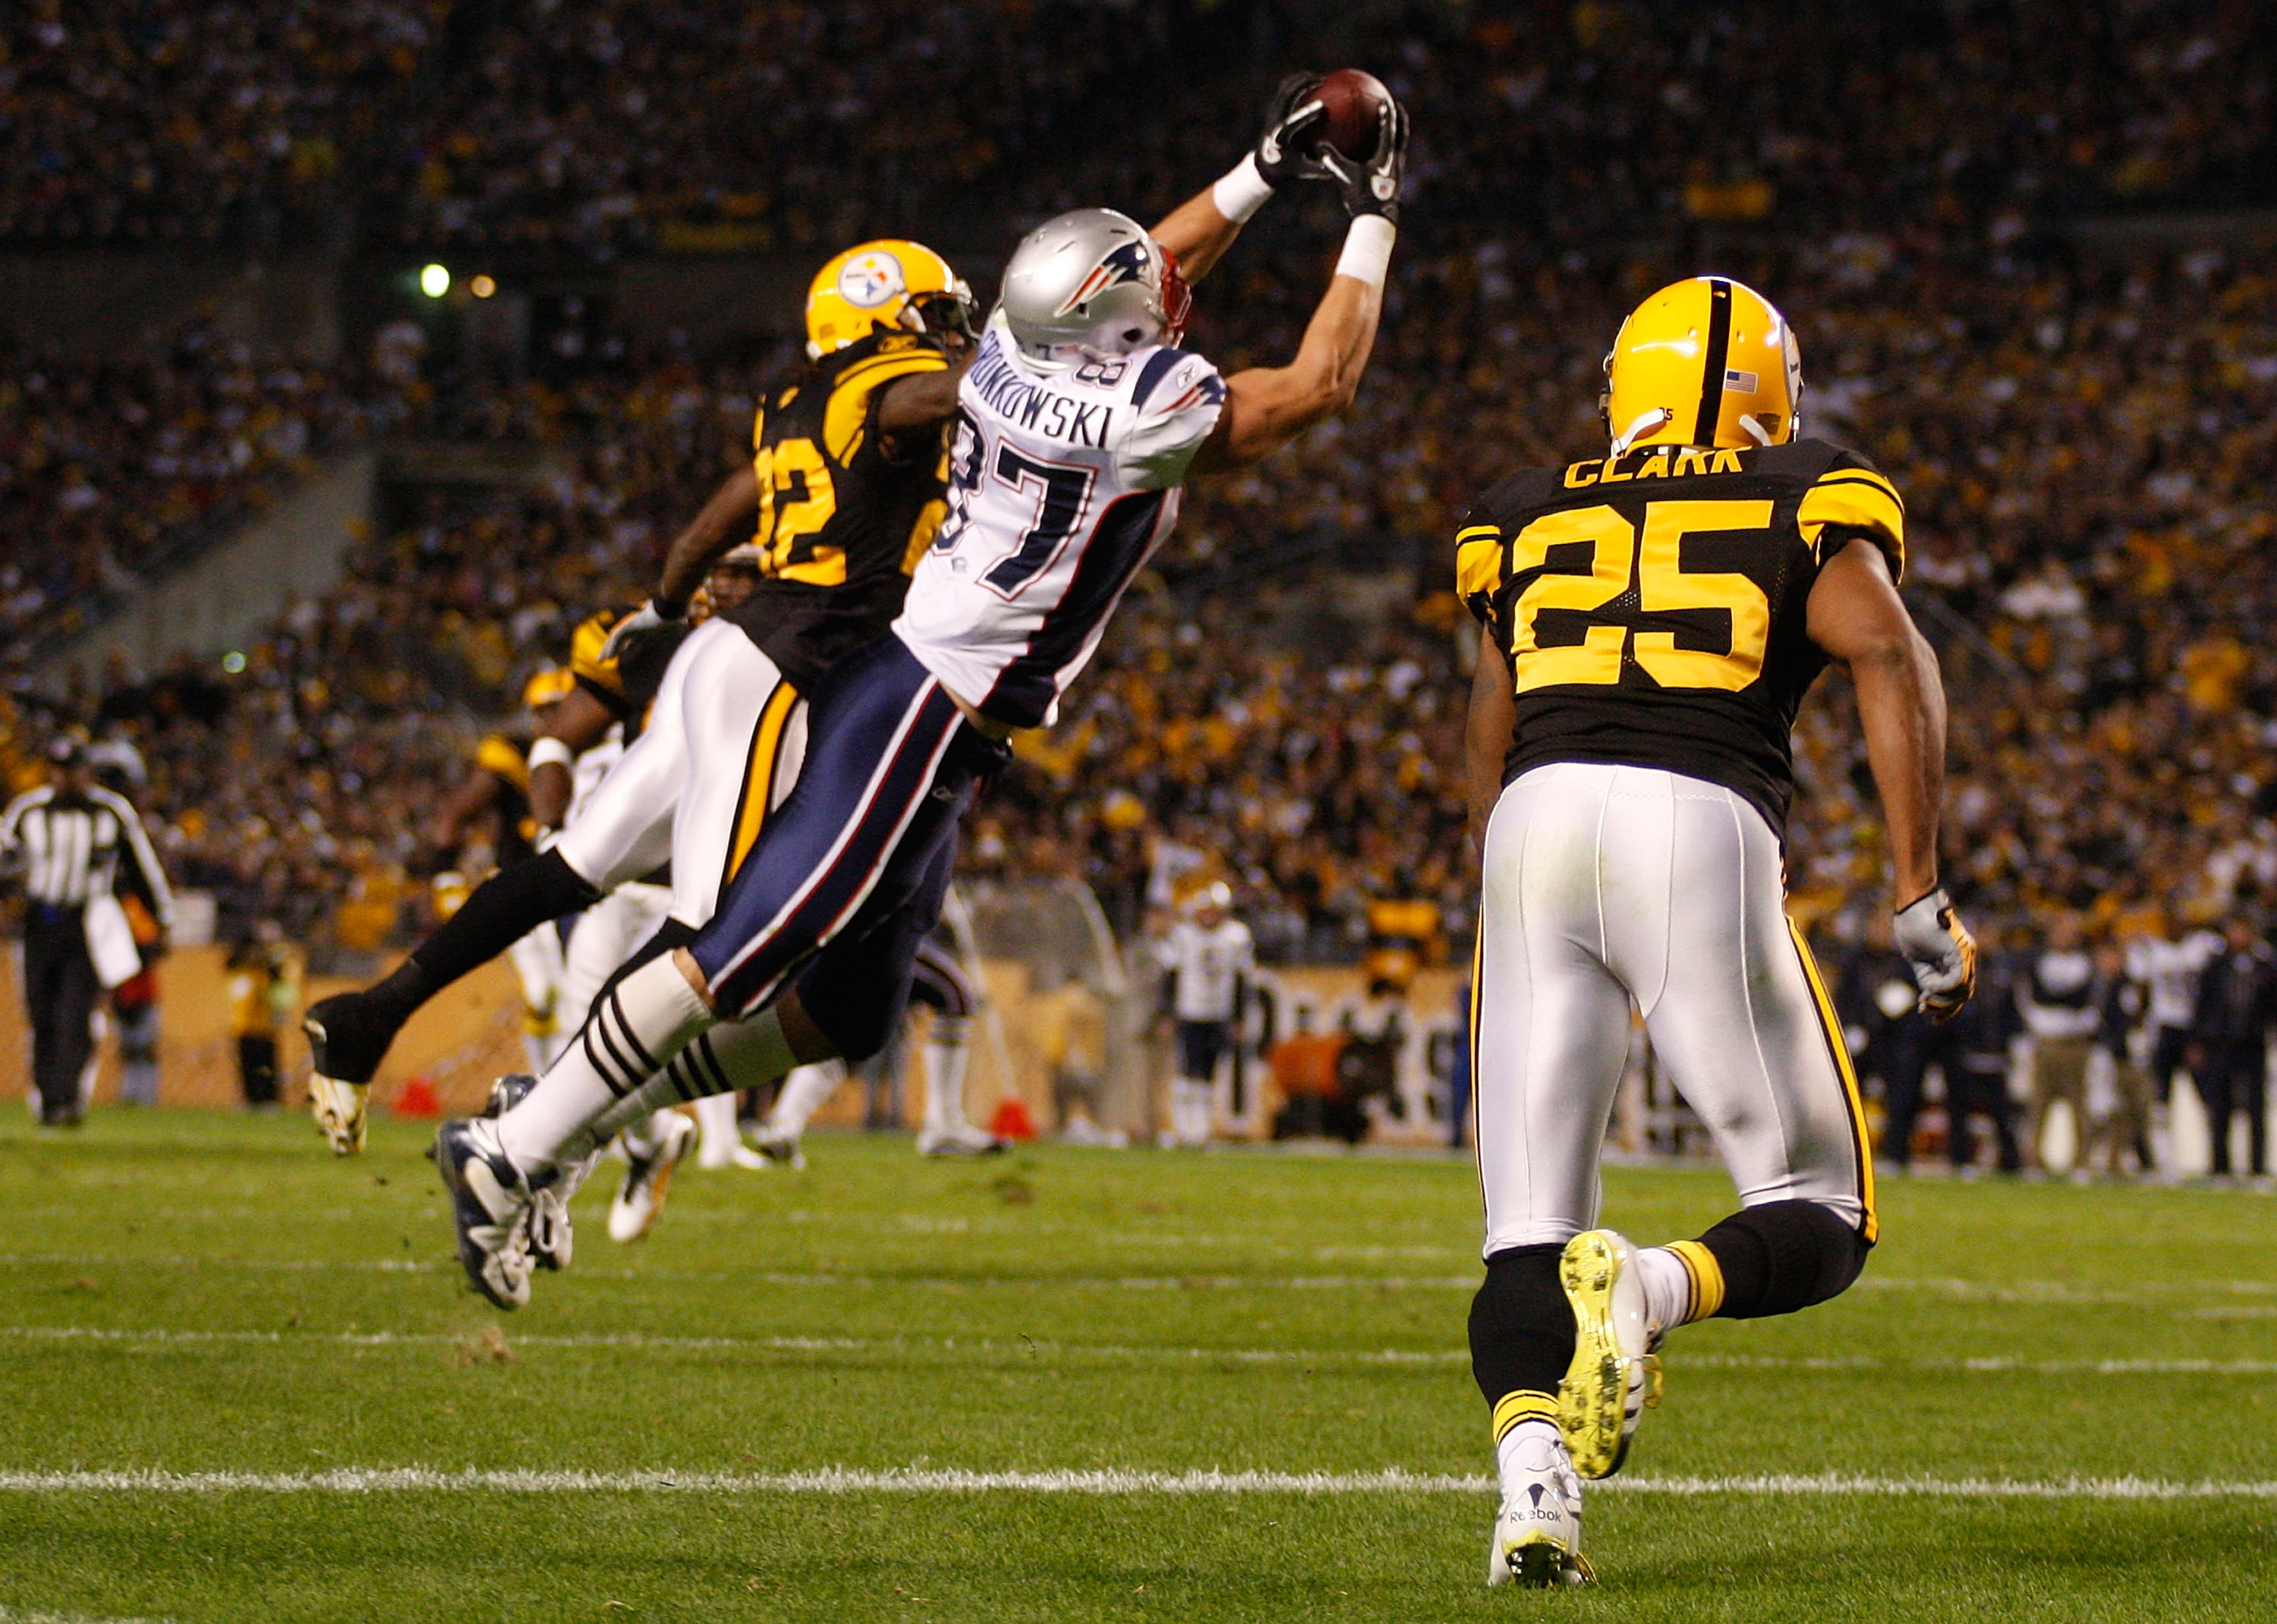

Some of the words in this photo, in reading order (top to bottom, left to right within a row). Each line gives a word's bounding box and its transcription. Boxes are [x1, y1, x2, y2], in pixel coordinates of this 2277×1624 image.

[970, 330, 1113, 448] GRONKOWSKI
[1564, 445, 1753, 489] CLARK
[1510, 499, 1774, 694] 25
[1510, 1507, 1562, 1525] Reebok
